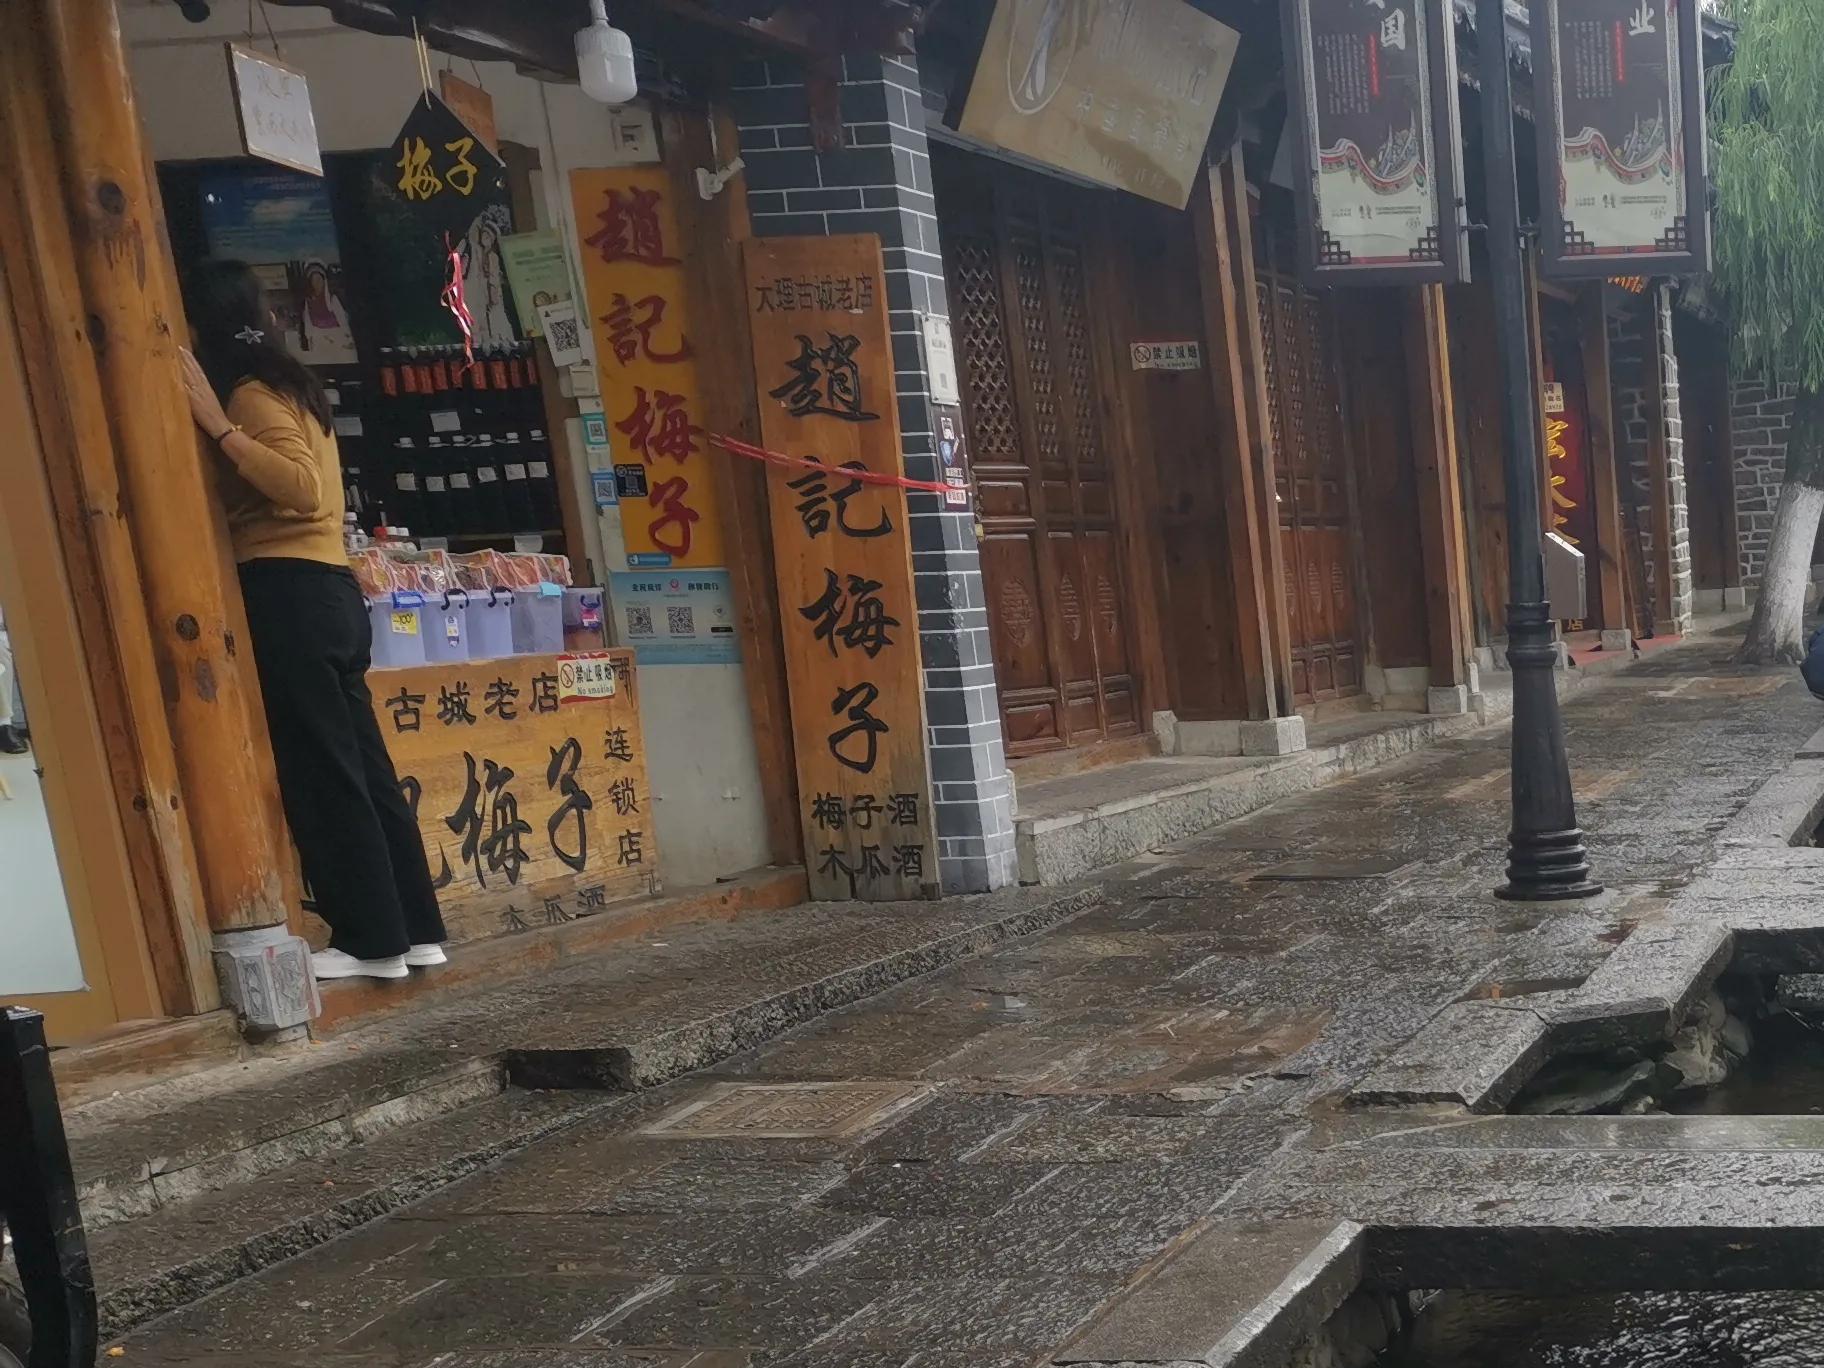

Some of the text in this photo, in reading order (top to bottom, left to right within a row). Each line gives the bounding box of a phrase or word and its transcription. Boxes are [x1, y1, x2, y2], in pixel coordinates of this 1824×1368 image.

[397, 136, 478, 200] 梅子
[1153, 344, 1198, 360] 禁止吸烟
[576, 661, 613, 683] 禁止吸烟
[577, 684, 613, 695] No smoking
[385, 671, 559, 733] 古城老店
[603, 727, 643, 867] 连锁店
[811, 792, 919, 831] 梅子酒
[818, 842, 923, 881] 木瓜酒
